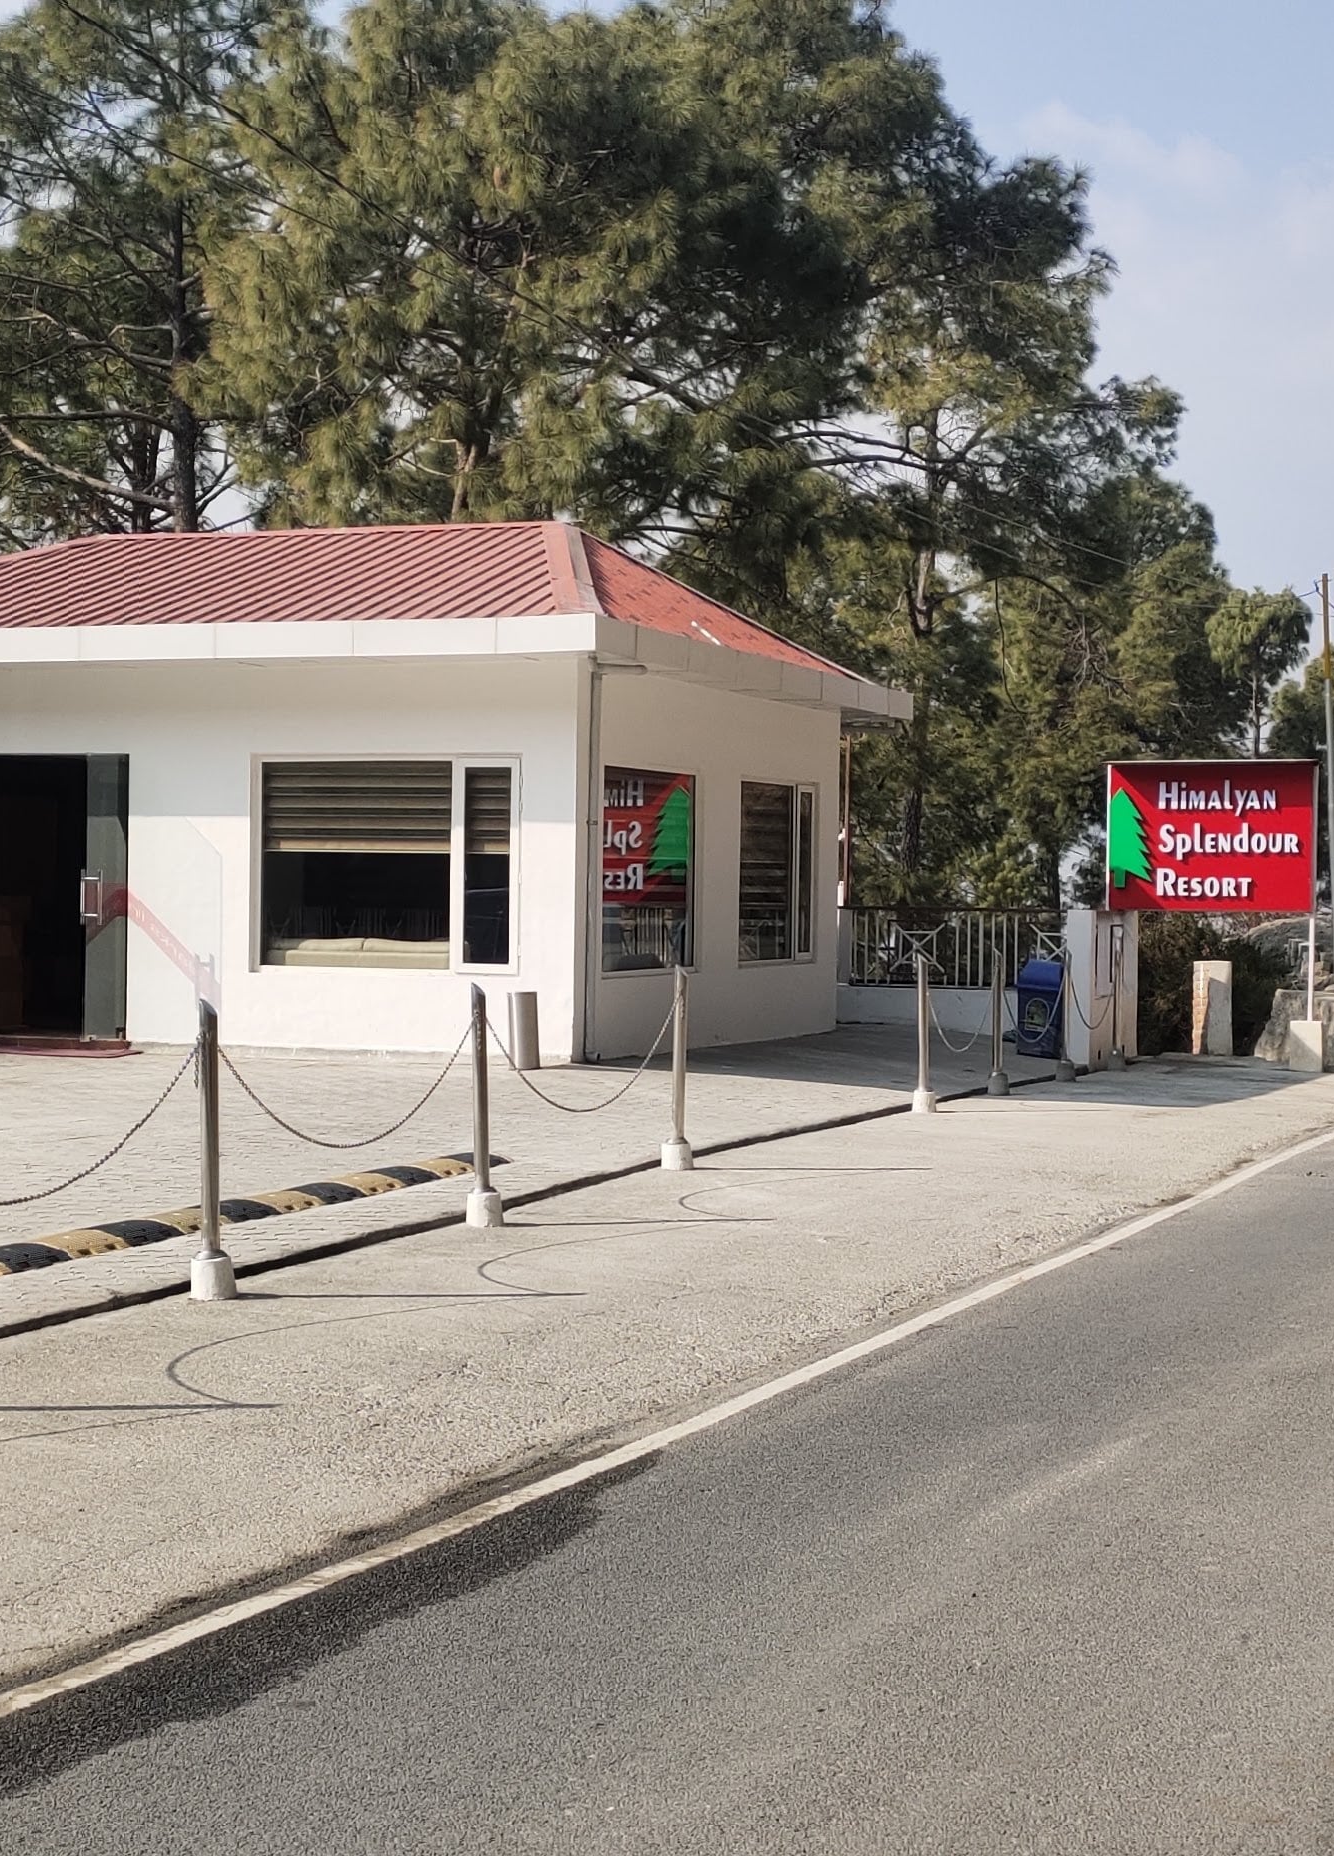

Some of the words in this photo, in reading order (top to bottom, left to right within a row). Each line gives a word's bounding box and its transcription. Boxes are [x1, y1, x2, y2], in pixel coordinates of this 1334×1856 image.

[1158, 779, 1277, 816] Himalyan
[1158, 822, 1300, 861] Splendour
[1156, 868, 1253, 897] Resort
